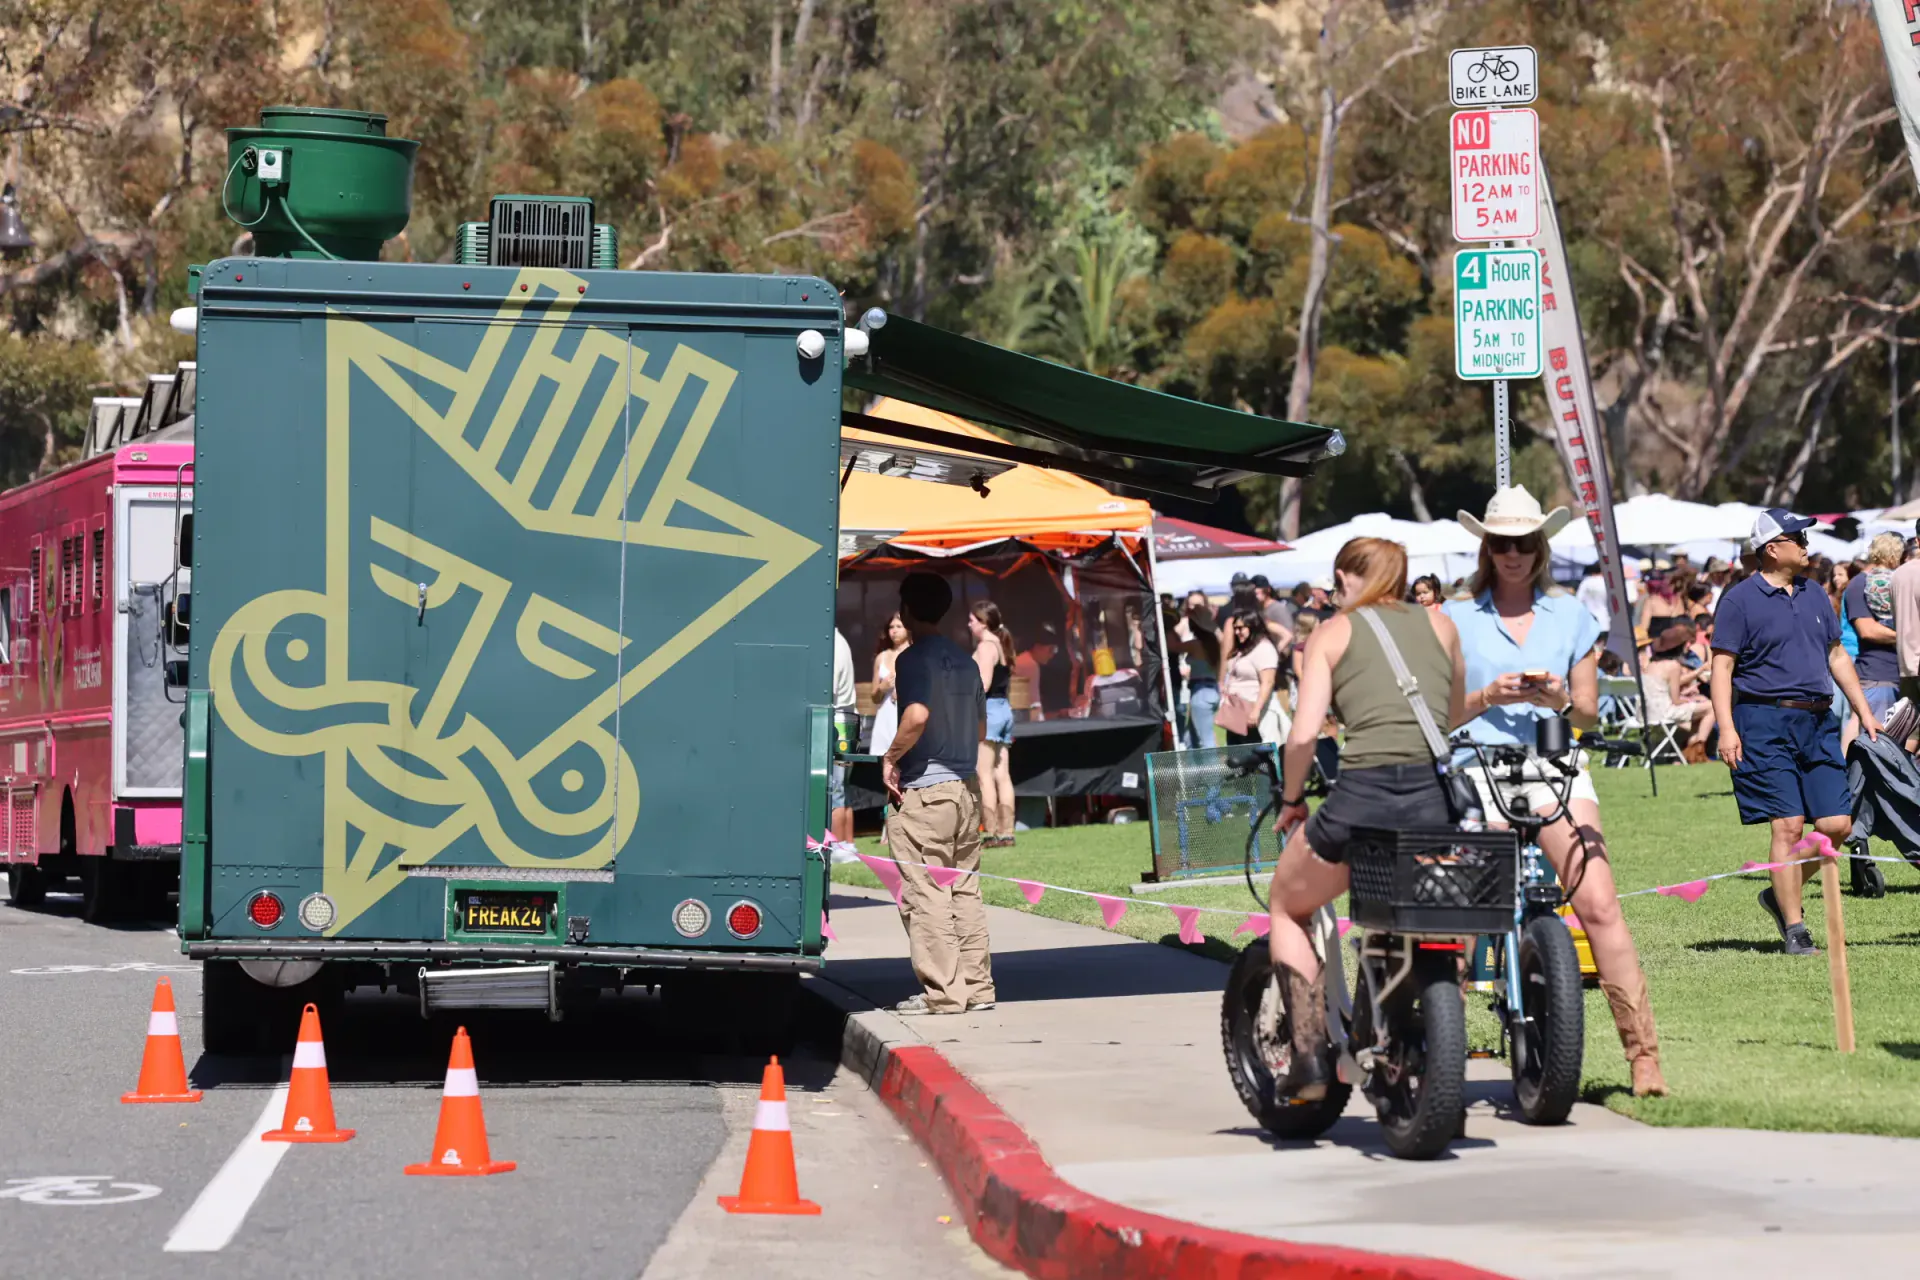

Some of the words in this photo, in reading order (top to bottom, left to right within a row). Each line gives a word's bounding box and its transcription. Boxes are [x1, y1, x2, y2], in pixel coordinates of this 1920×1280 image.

[1456, 86, 1487, 99] BIKE
[1493, 84, 1531, 97] LANE
[1457, 118, 1486, 145] NO
[1459, 152, 1530, 178] PARKING
[1518, 185, 1530, 195] TO
[1461, 256, 1481, 284] 4
[1491, 263, 1531, 282] HOUR
[1462, 298, 1534, 322] PARKING
[1511, 332, 1525, 347] TO
[1472, 352, 1526, 368] MIDNIGHT
[147, 491, 194, 499] EMERGECY
[468, 905, 542, 926] FREAK24
